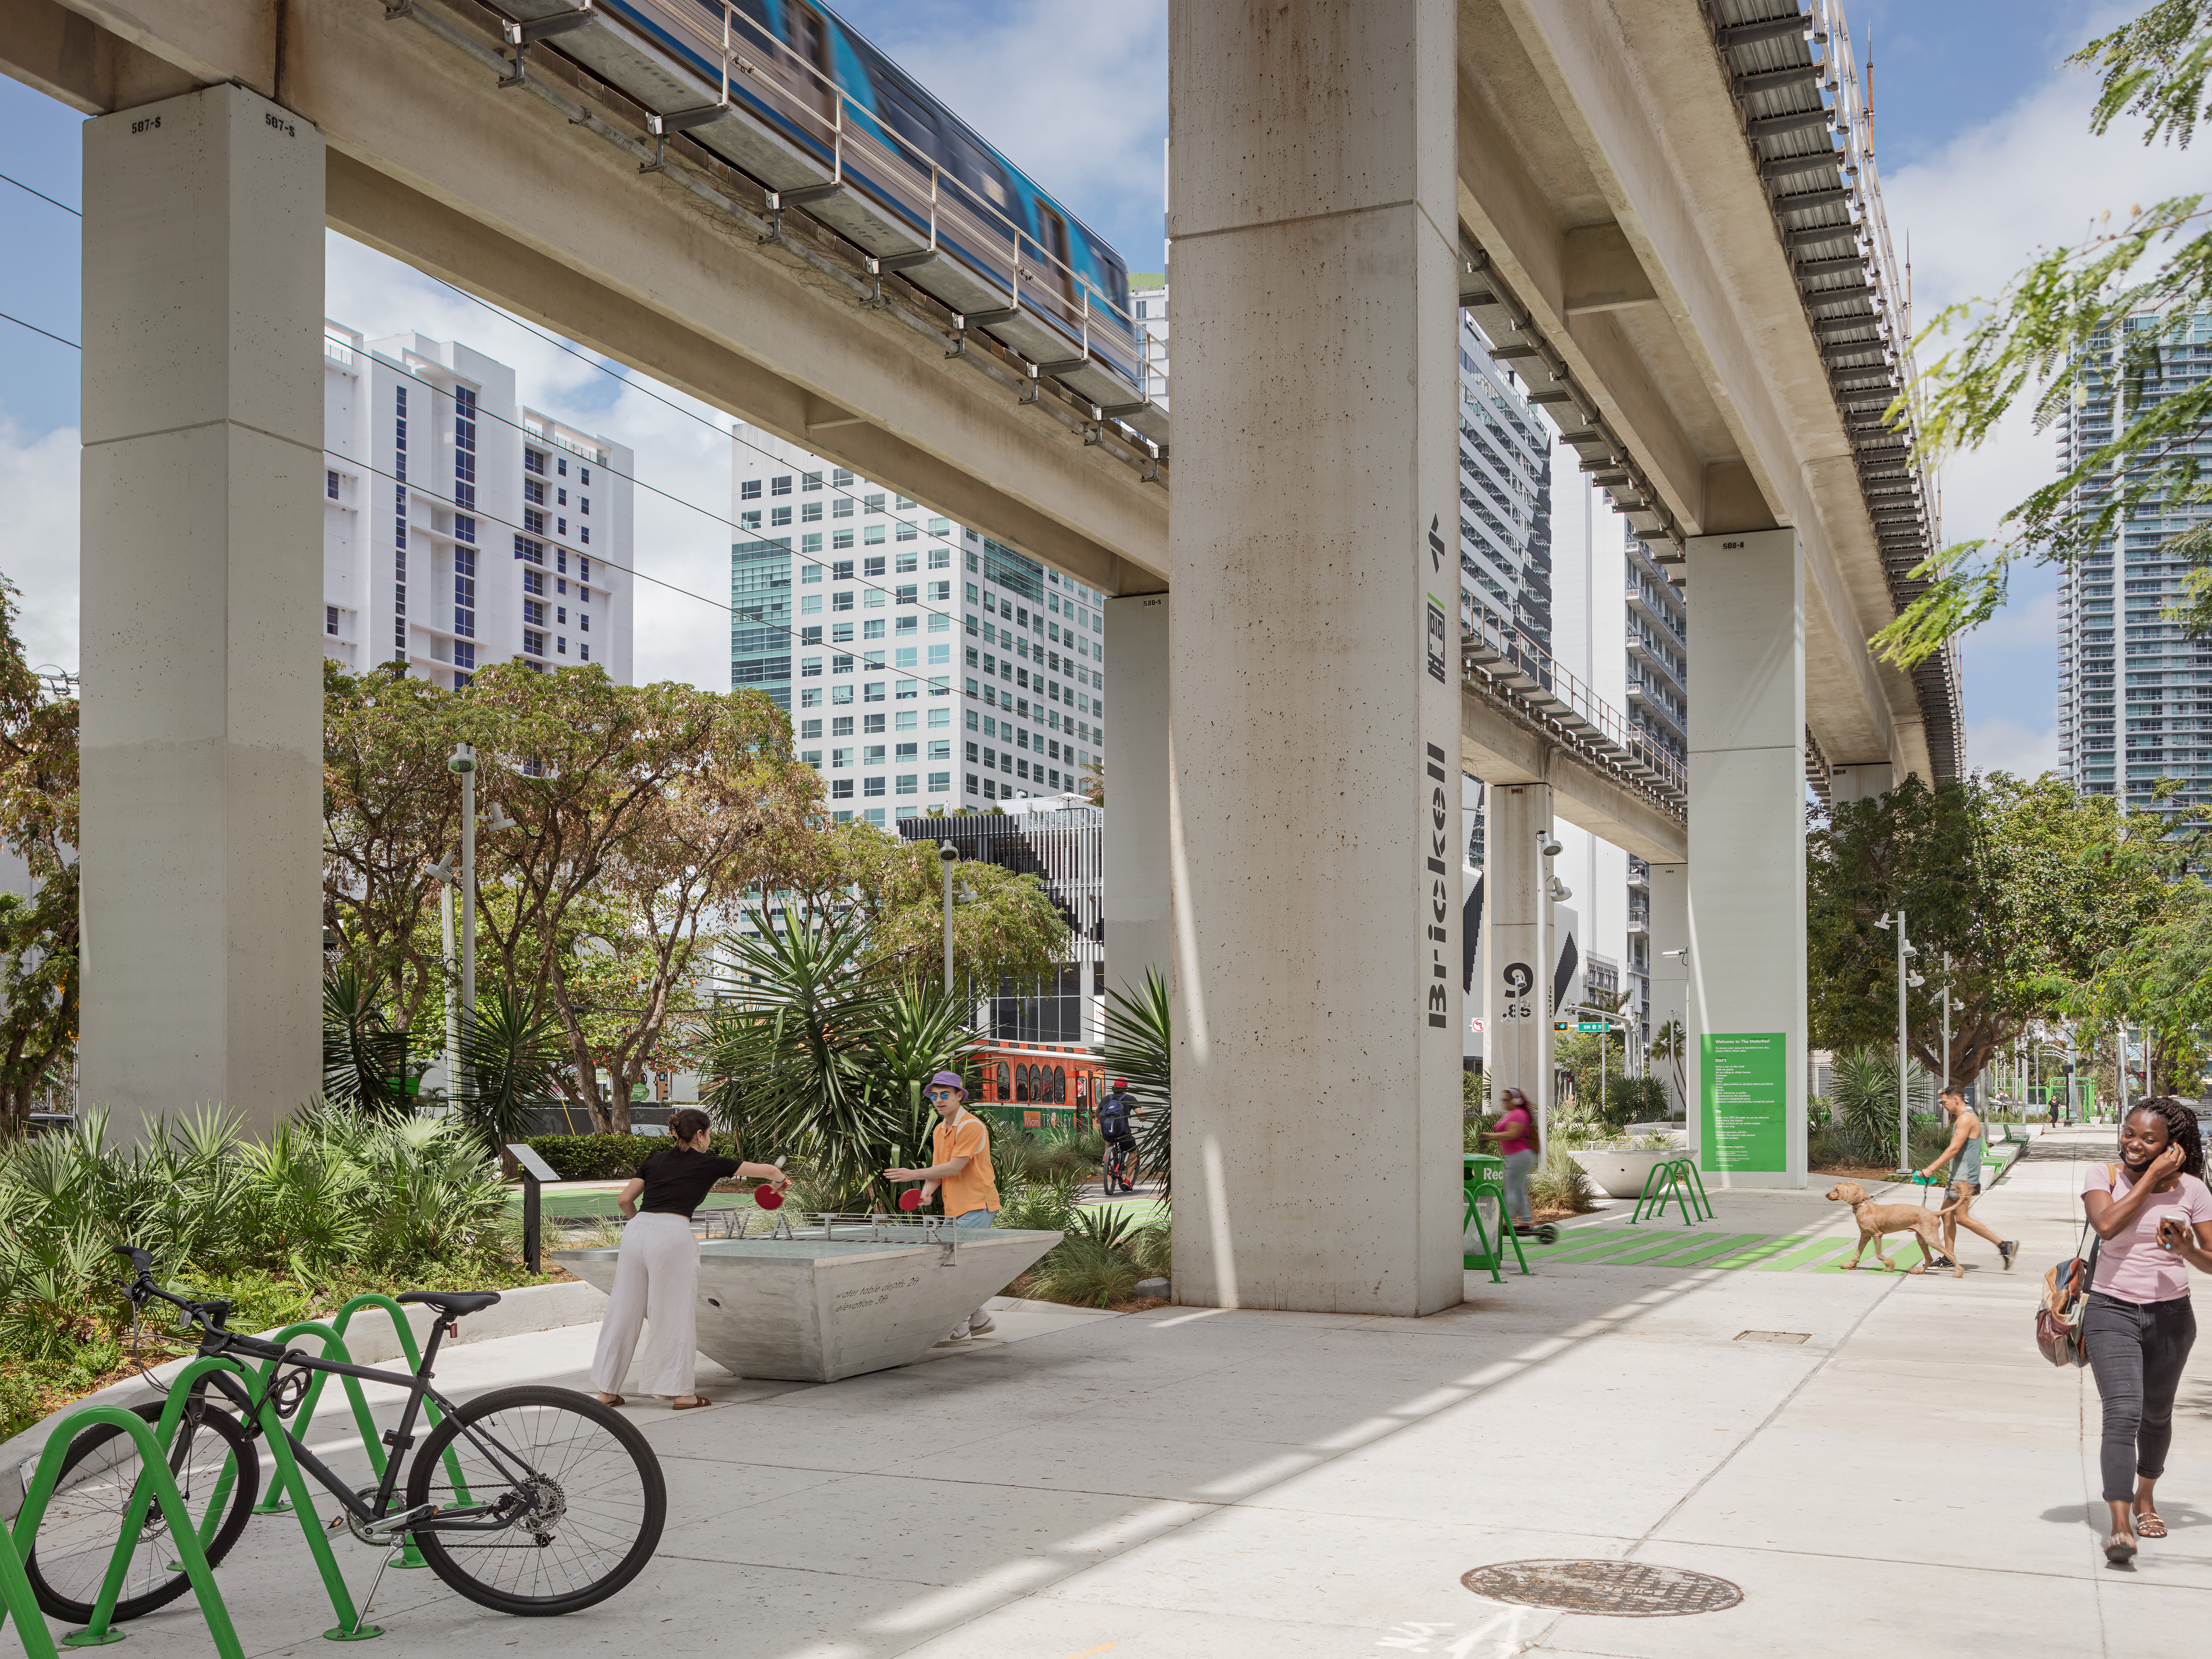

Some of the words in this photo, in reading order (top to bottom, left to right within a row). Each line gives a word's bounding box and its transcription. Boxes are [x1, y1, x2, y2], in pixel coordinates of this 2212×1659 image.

[132, 116, 161, 134] 587-S
[266, 113, 295, 137] 587-S
[1427, 741, 1446, 1029] Brickell
[1503, 963, 1533, 998] 9
[1025, 1116, 1040, 1126] Miami
[719, 1212, 942, 1243] WATER
[836, 1289, 859, 1299] water
[860, 1283, 880, 1295] table
[882, 1279, 906, 1292] depth:
[906, 1276, 920, 1287] 2ft
[836, 1299, 873, 1313] elevation:
[875, 1294, 889, 1305] 3ft
